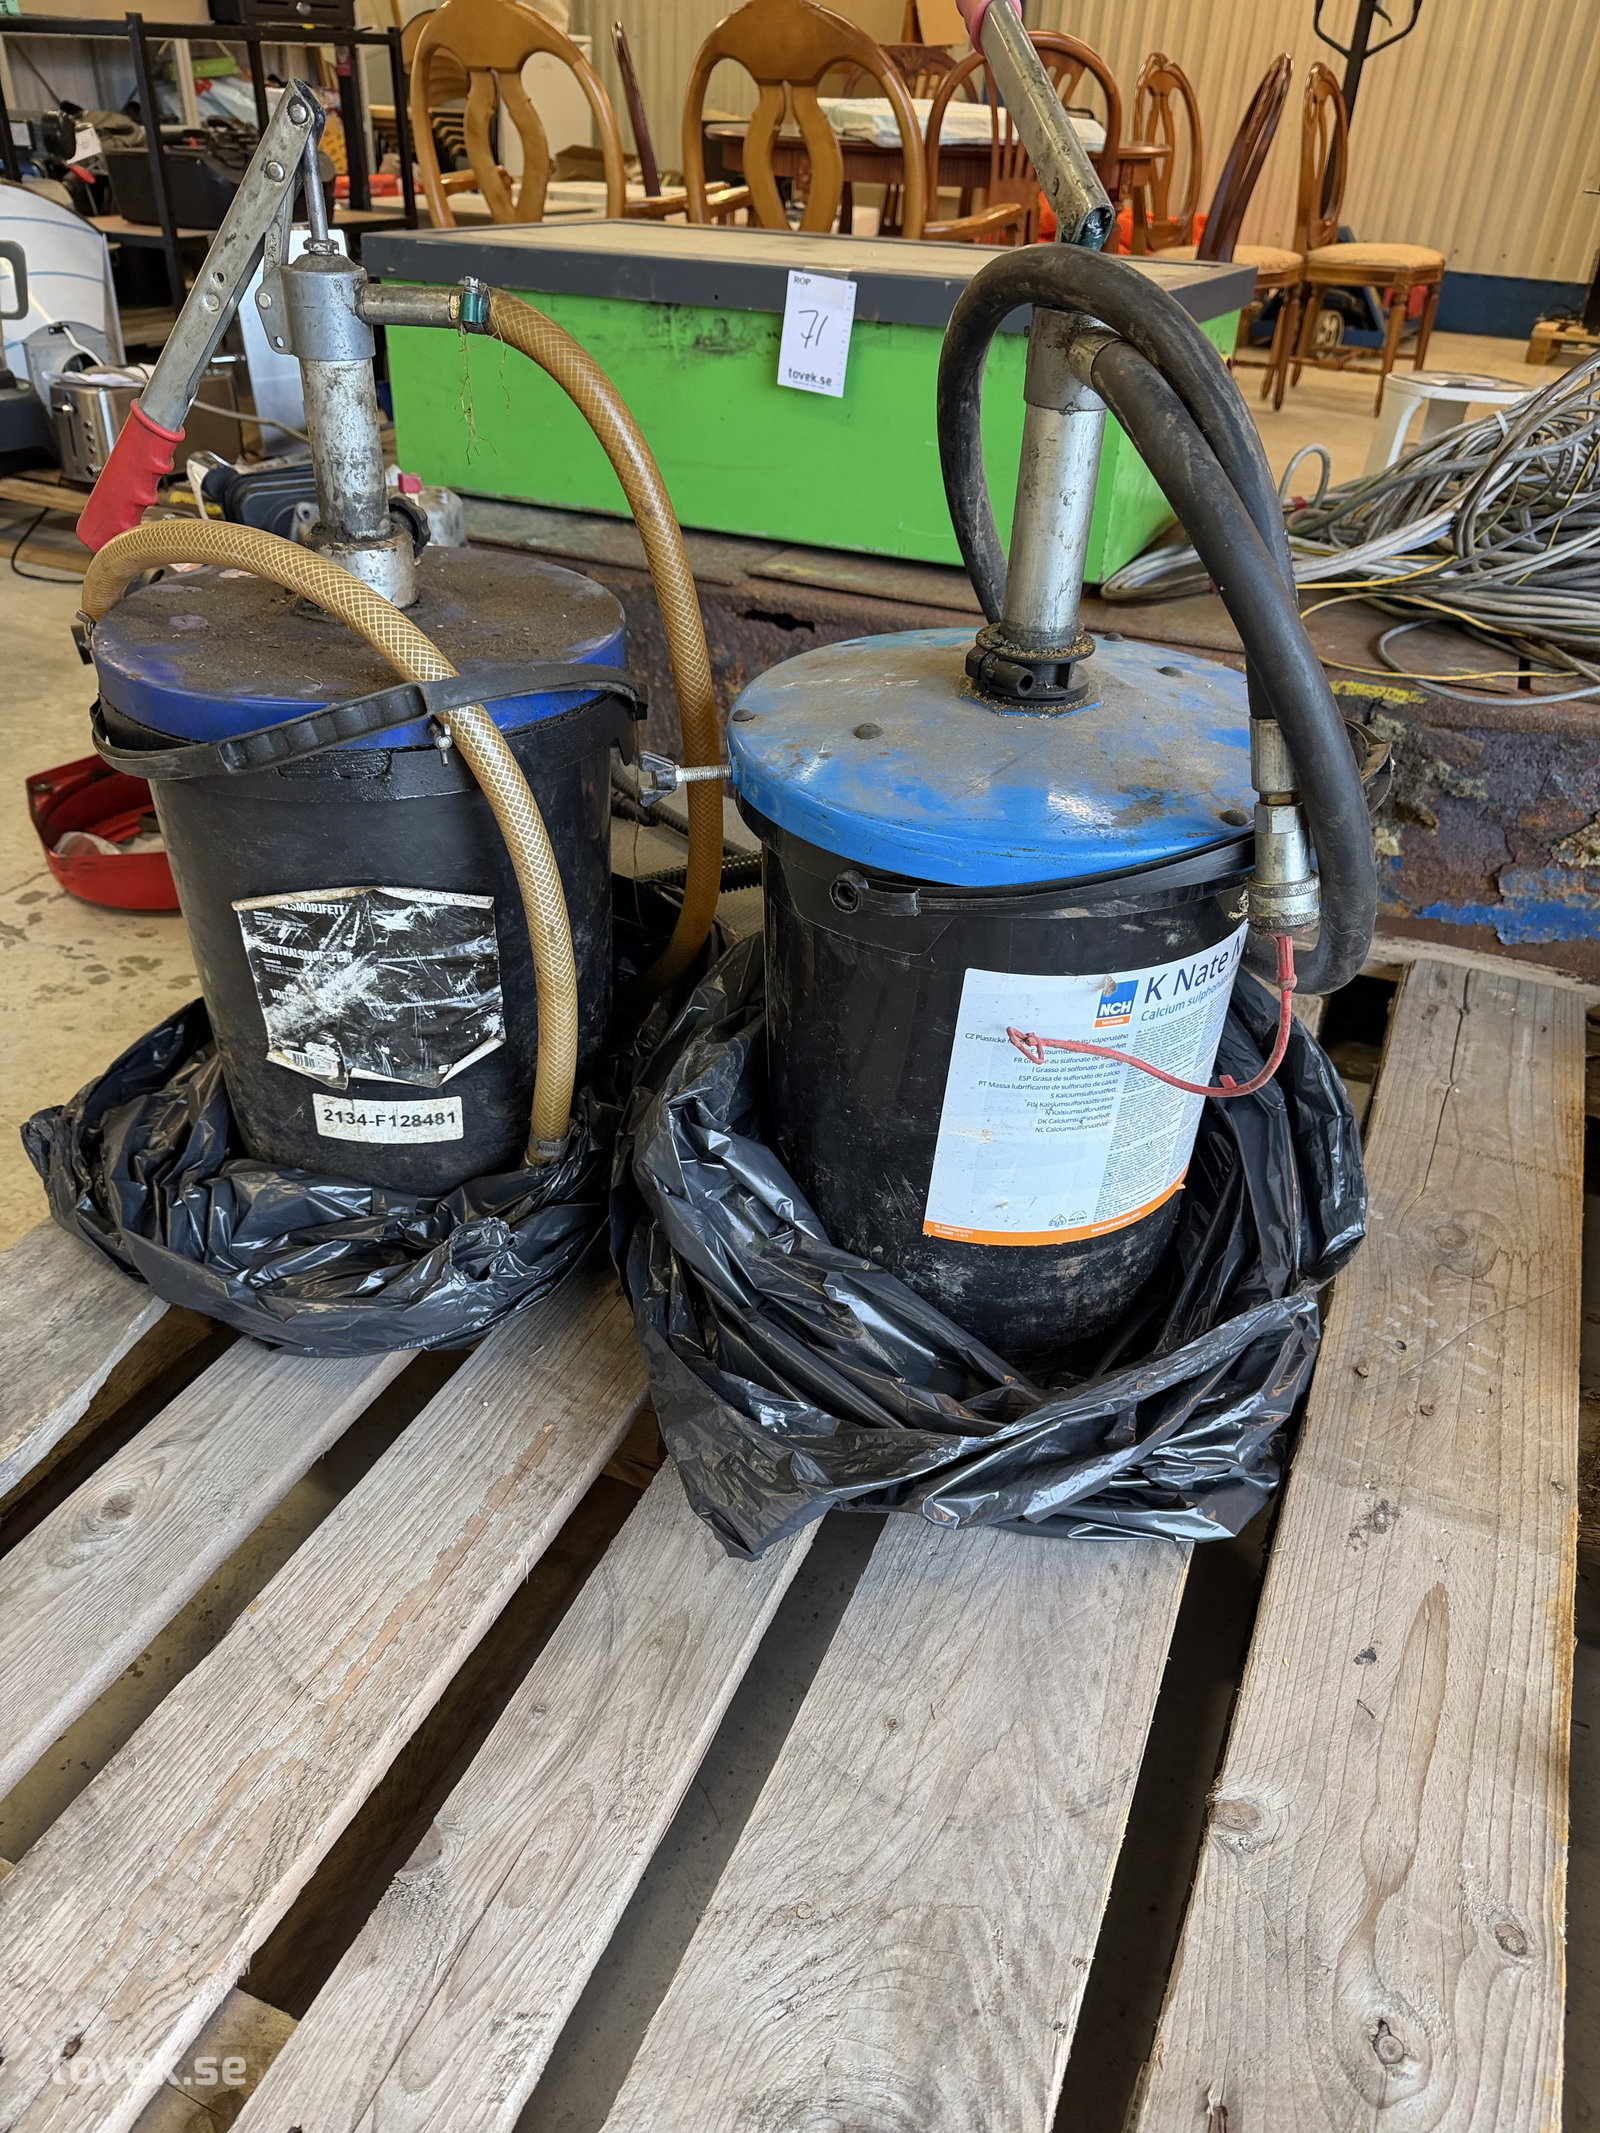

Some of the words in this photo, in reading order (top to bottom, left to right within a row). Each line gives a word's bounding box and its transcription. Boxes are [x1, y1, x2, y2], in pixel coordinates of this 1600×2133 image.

[798, 310, 828, 349] 71
[788, 367, 832, 386] tovek.se
[1144, 973, 1168, 1004] K
[1173, 951, 1229, 996] Nate
[1141, 1001, 1185, 1021] Calcium
[1187, 973, 1230, 1007] sulphonate
[1100, 1000, 1132, 1017] NCH
[975, 1034, 1006, 1044] Plastické
[1036, 1066, 1060, 1074] Grasso
[1068, 1064, 1098, 1073] solfonato
[1105, 1060, 1122, 1069] calcio
[1060, 1056, 1087, 1064] sulfonate
[1032, 1075, 1052, 1083] Grasa
[1063, 1073, 1093, 1082] sulfonato
[1104, 1069, 1120, 1078] calcio
[988, 1081, 1010, 1089] Massa
[1012, 1082, 1050, 1091] lubrificante
[1051, 1083, 1061, 1091] de
[1061, 1082, 1091, 1091] sulfonato
[323, 1108, 456, 1128] 2134-F128481
